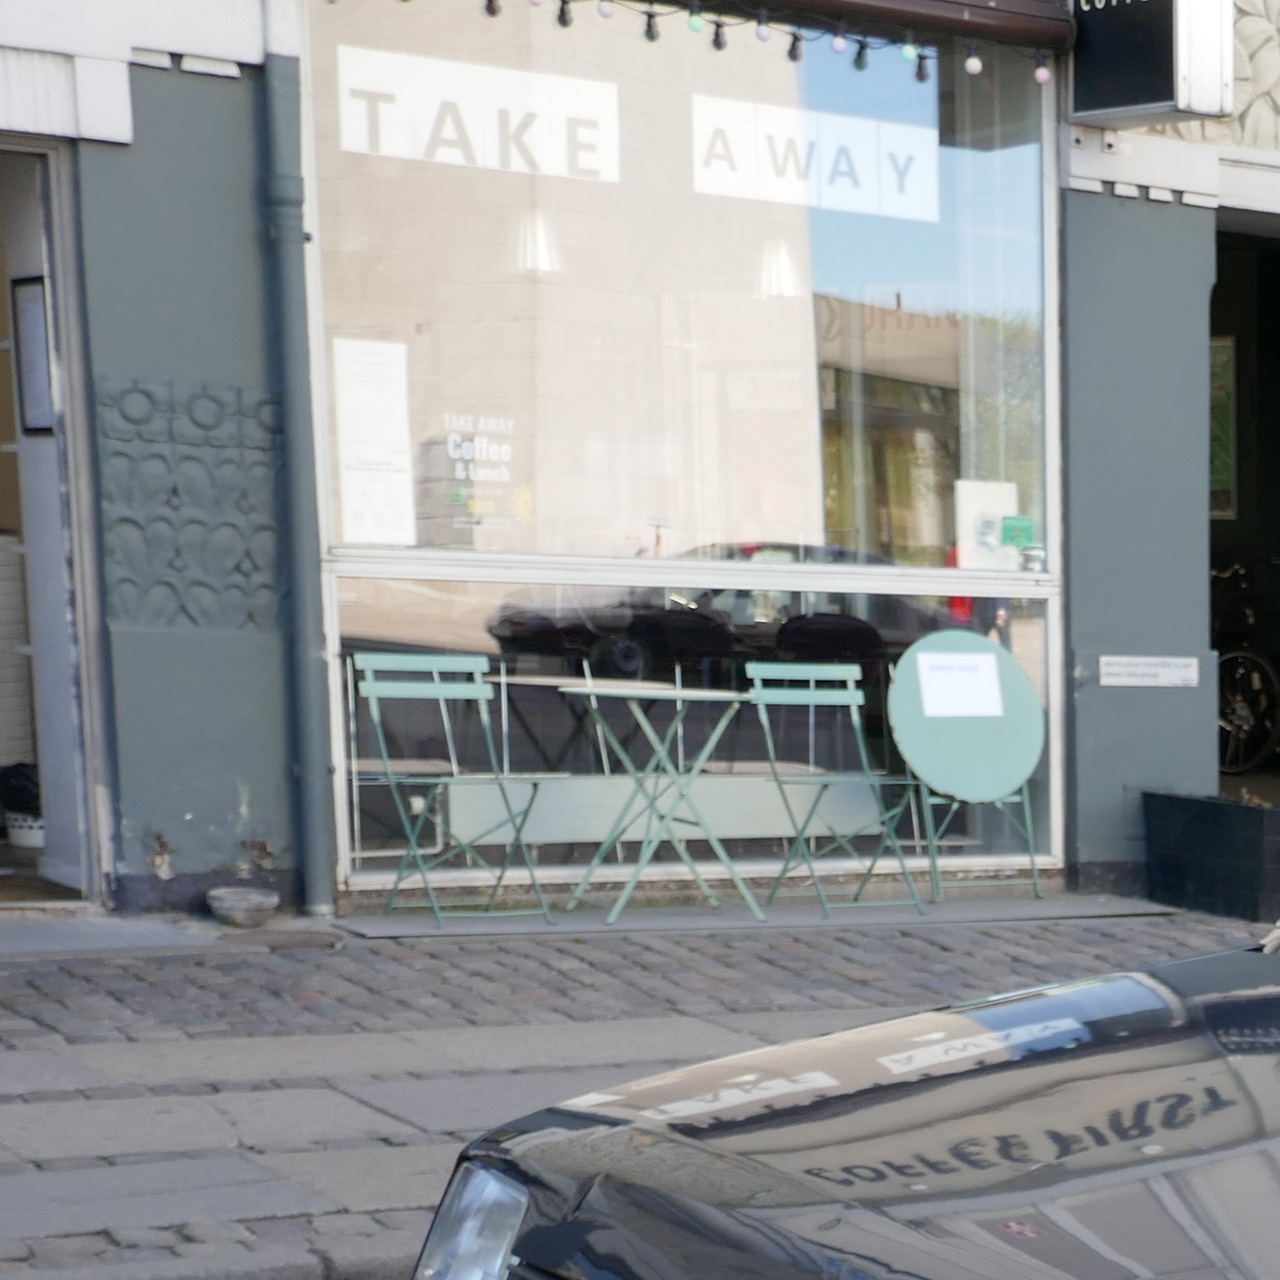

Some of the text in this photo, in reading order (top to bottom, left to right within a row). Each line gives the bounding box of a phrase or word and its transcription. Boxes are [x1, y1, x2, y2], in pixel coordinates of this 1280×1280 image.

[350, 88, 914, 194] TAKE AWAY
[448, 434, 512, 462] Coffee
